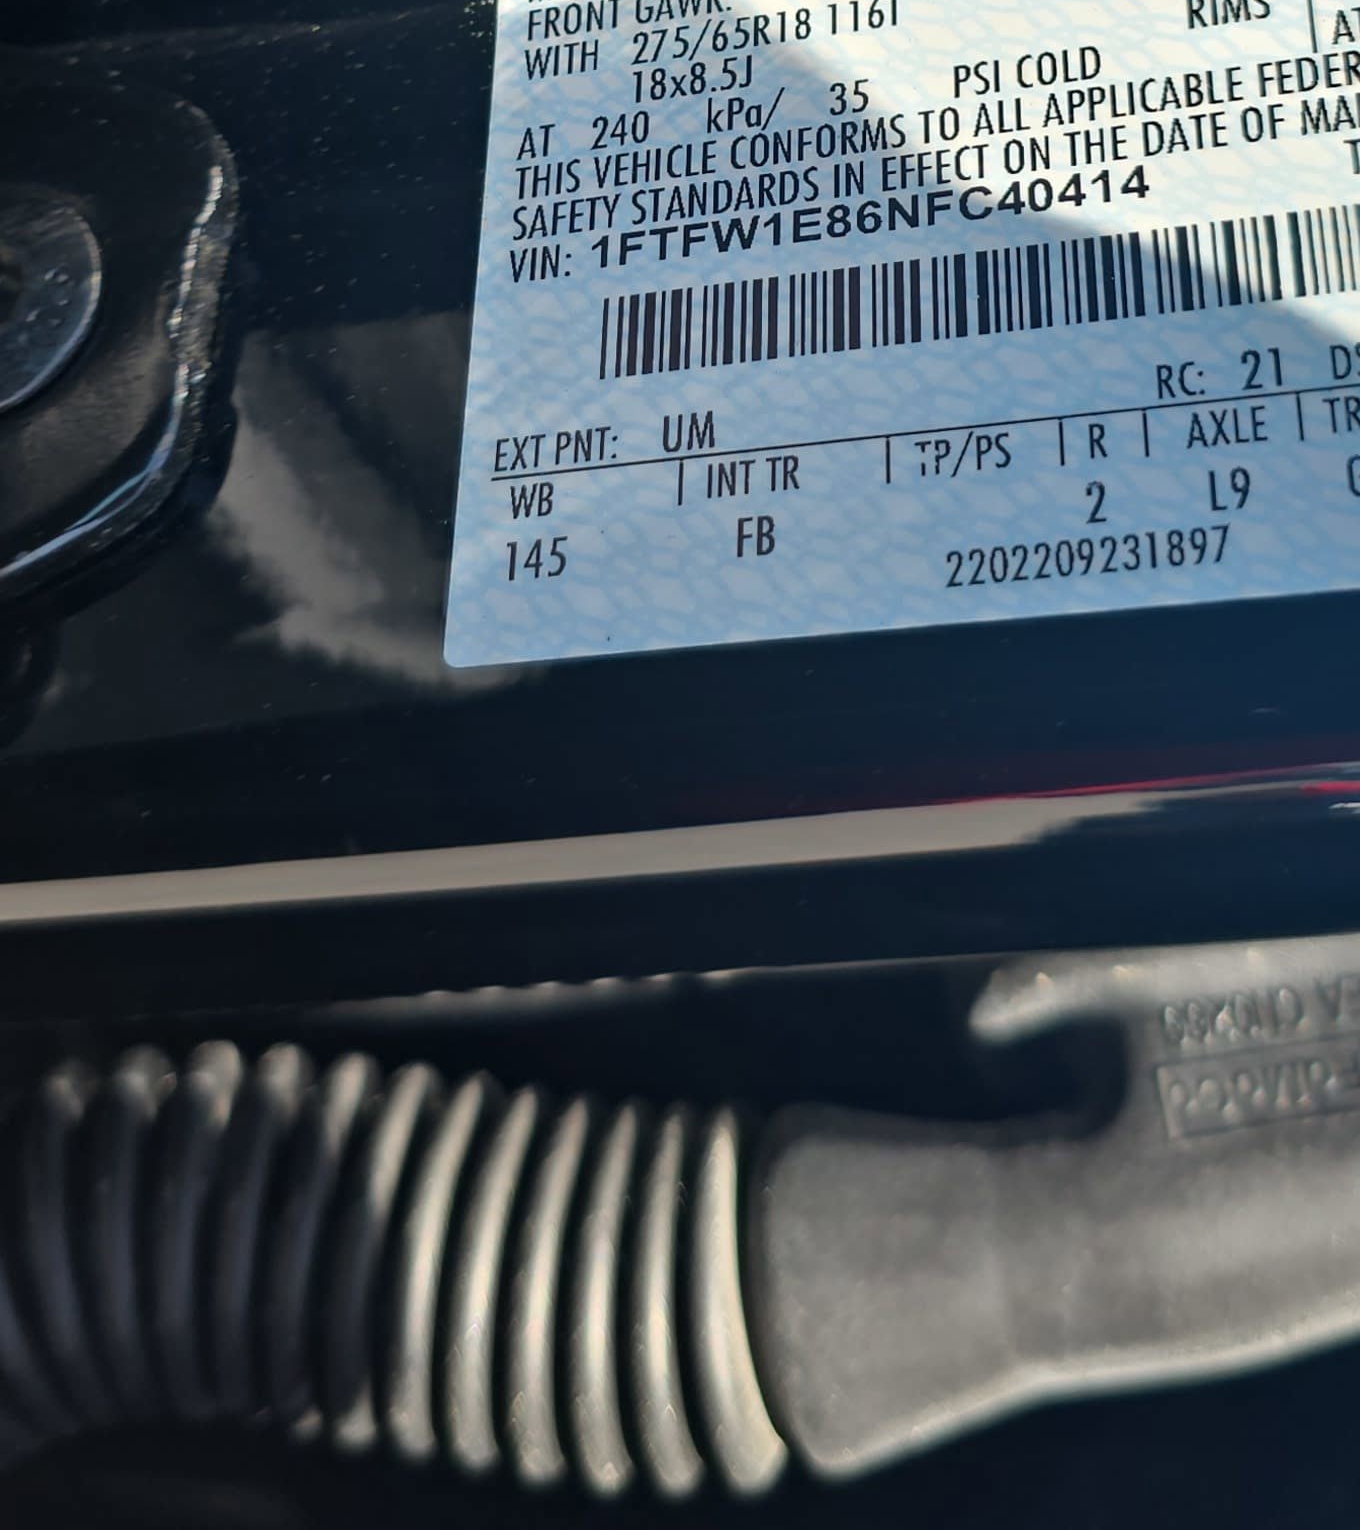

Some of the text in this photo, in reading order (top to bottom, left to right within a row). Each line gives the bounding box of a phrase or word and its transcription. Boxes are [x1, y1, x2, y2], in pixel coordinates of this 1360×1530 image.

[525, 40, 598, 81] WITH
[632, 9, 811, 65] 275/65R18
[634, 56, 753, 103] 18x8.5J
[516, 159, 581, 199] THIS
[594, 140, 717, 186] VEHICLE
[730, 113, 907, 168] CONFORMS
[918, 107, 960, 143] TO
[973, 98, 1031, 137] ALL
[1043, 66, 1243, 128] APPLICABLE
[517, 46, 1102, 160] AT 240 kPa/ 35 PSI COLD
[509, 165, 1150, 283] VIN: 1FTFW1E86NFC40414
[513, 194, 620, 241] SAFETY
[631, 166, 819, 224] STANDARDS
[833, 161, 864, 198] IN
[881, 144, 985, 192] EFFECT
[1003, 136, 1051, 175] ON
[1063, 126, 1129, 167] THE
[1142, 112, 1228, 157] DATE
[1240, 104, 1289, 144] OF
[1156, 362, 1205, 399] RC:
[1240, 347, 1283, 390] 21
[495, 411, 716, 472] EXT PNT: UM
[510, 482, 554, 519] WB
[706, 460, 755, 499] INT
[766, 455, 800, 492] TR
[914, 430, 1012, 479] TP/PS
[1089, 423, 1107, 459] R
[1186, 406, 1268, 450] AXLE
[506, 536, 568, 581] 145
[737, 515, 776, 558] FB
[1085, 482, 1107, 524] 2
[1207, 467, 1252, 512] L9
[946, 524, 1231, 588] 2202209231897
